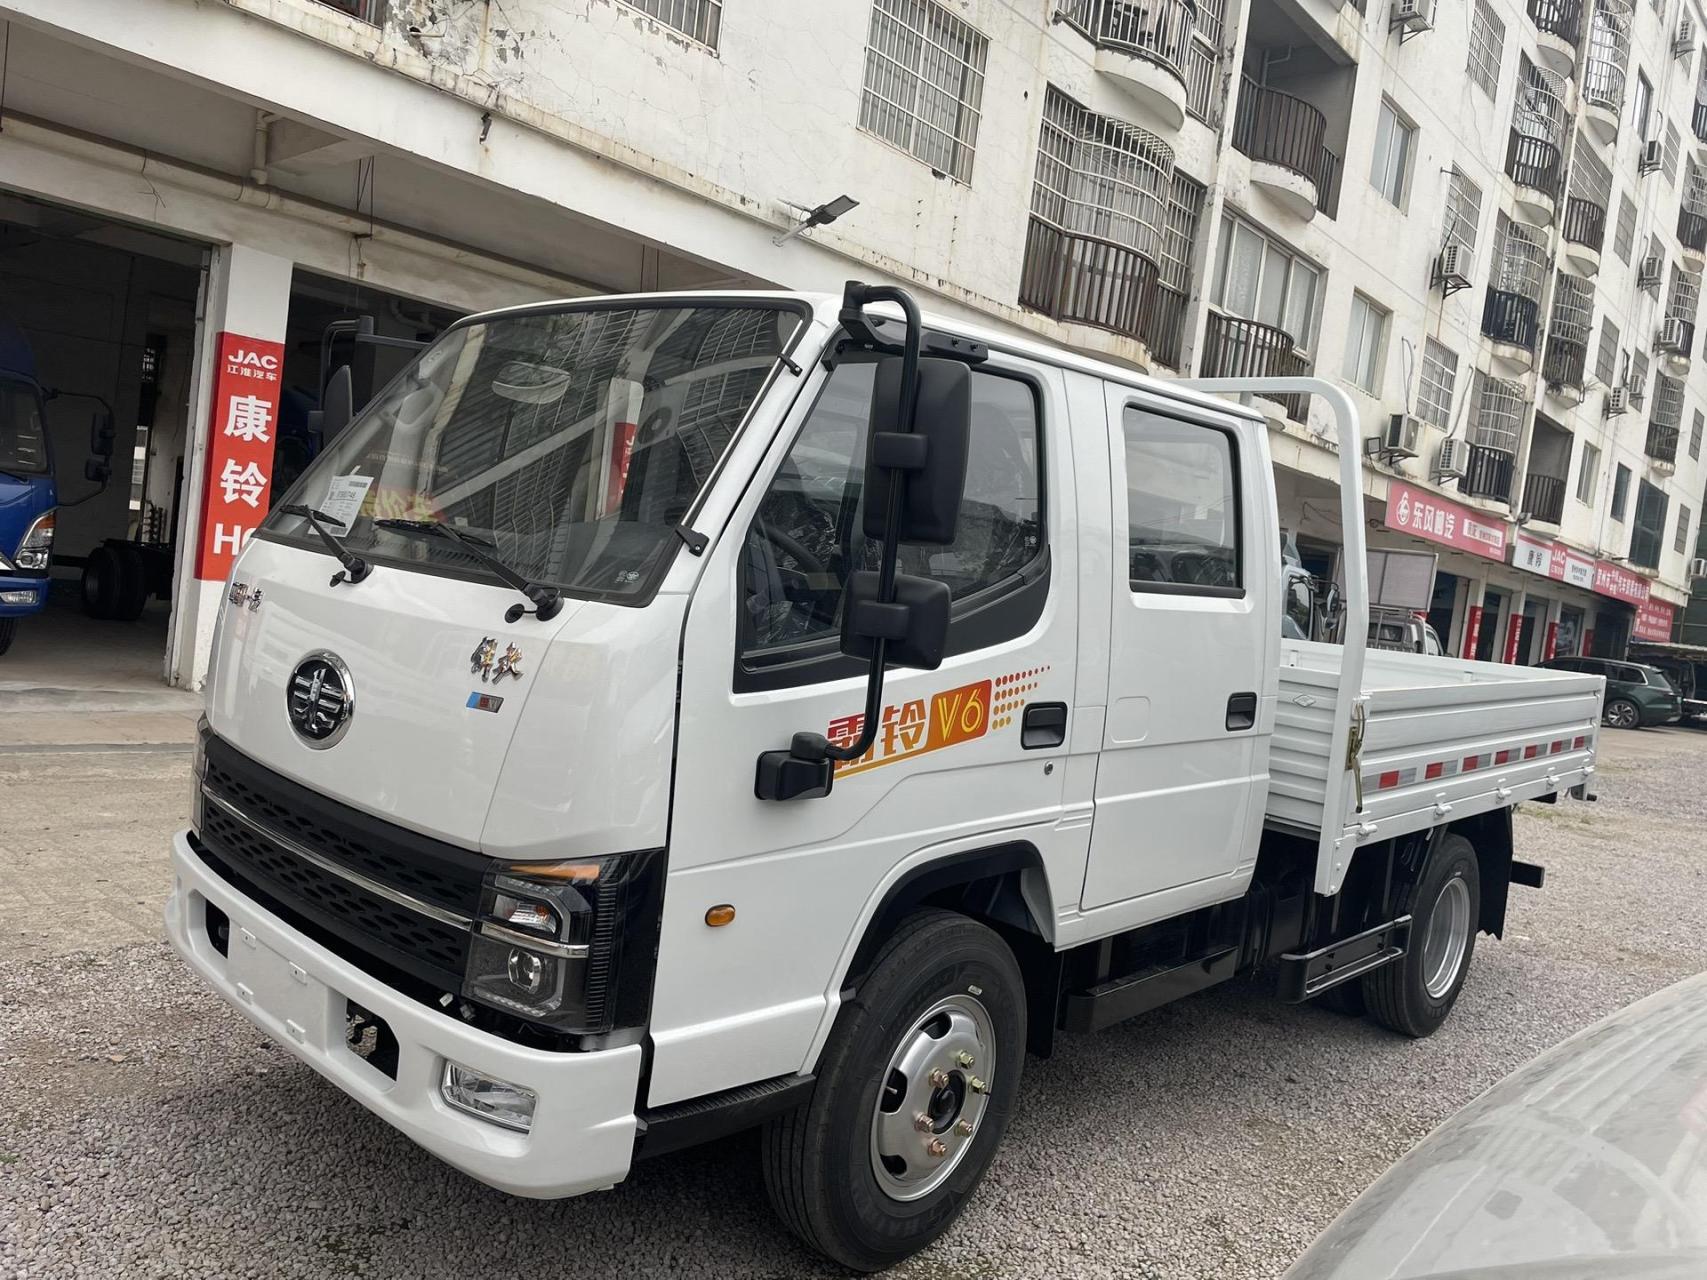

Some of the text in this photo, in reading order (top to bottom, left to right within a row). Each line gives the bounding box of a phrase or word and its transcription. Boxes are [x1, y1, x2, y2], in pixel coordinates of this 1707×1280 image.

[227, 364, 278, 382] 江淮汽车
[228, 350, 278, 370] JAC
[220, 395, 272, 509] 康铃
[938, 687, 985, 743] V6
